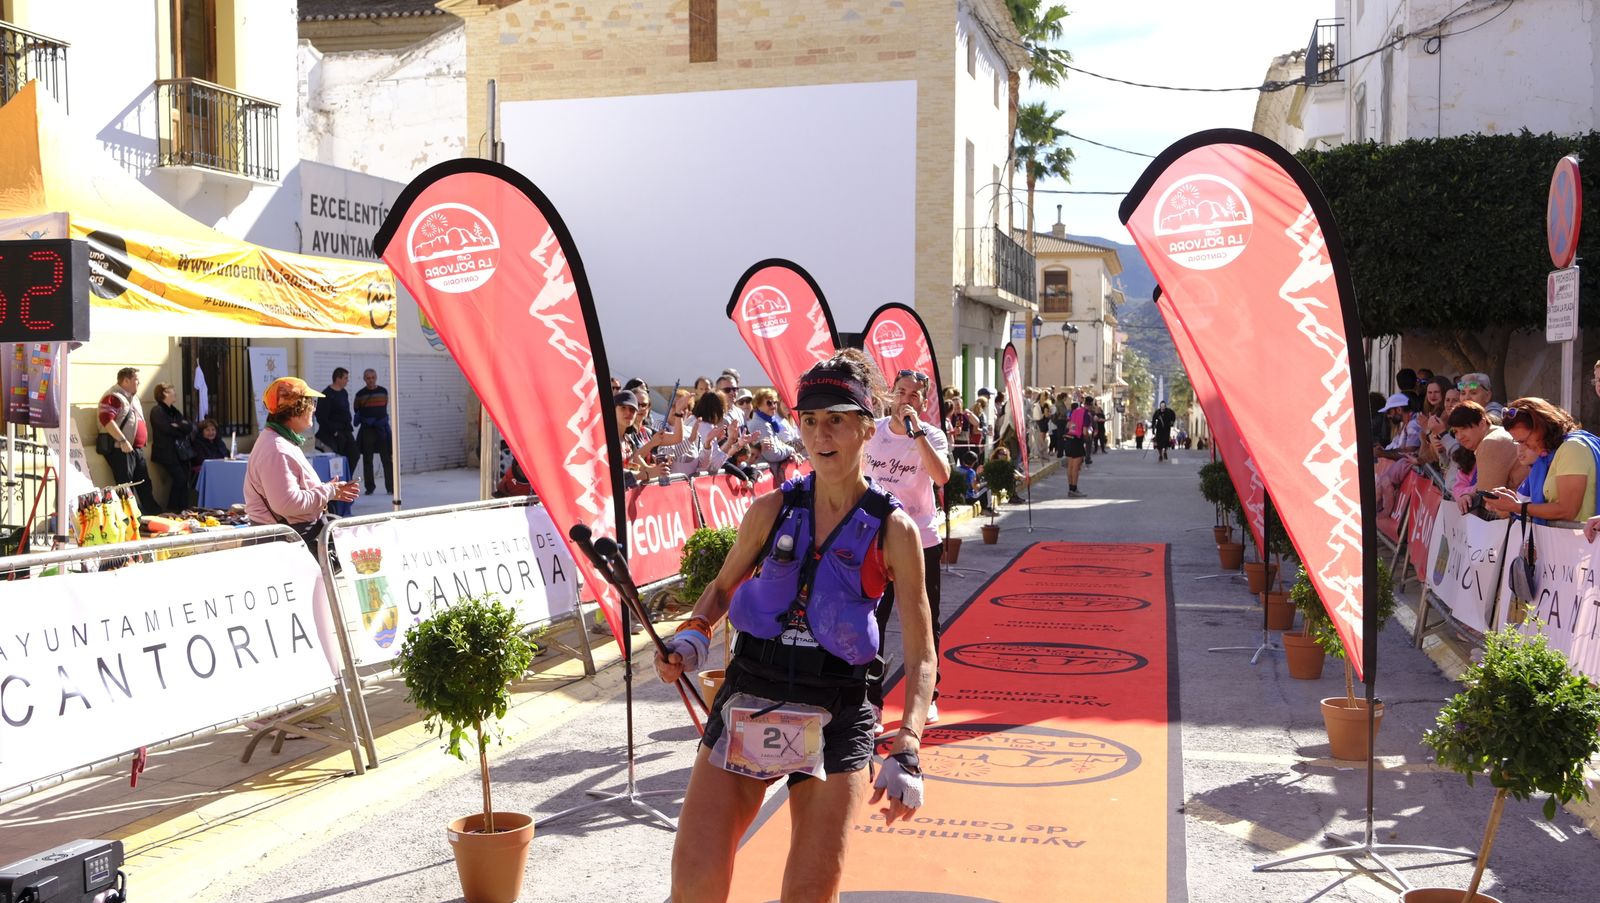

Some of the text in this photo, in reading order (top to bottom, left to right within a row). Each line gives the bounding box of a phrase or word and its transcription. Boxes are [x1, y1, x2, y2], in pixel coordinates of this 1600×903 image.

[401, 532, 556, 571] AYUNTAMIENTO DE
[266, 581, 296, 606] DE
[405, 553, 566, 615] CANTORIA
[0, 612, 314, 728] CANTORIA
[939, 694, 1112, 707] Ayuntamiento
[959, 689, 1061, 699] Cantoria
[1068, 741, 1106, 749] LA
[1025, 824, 1069, 835] de
